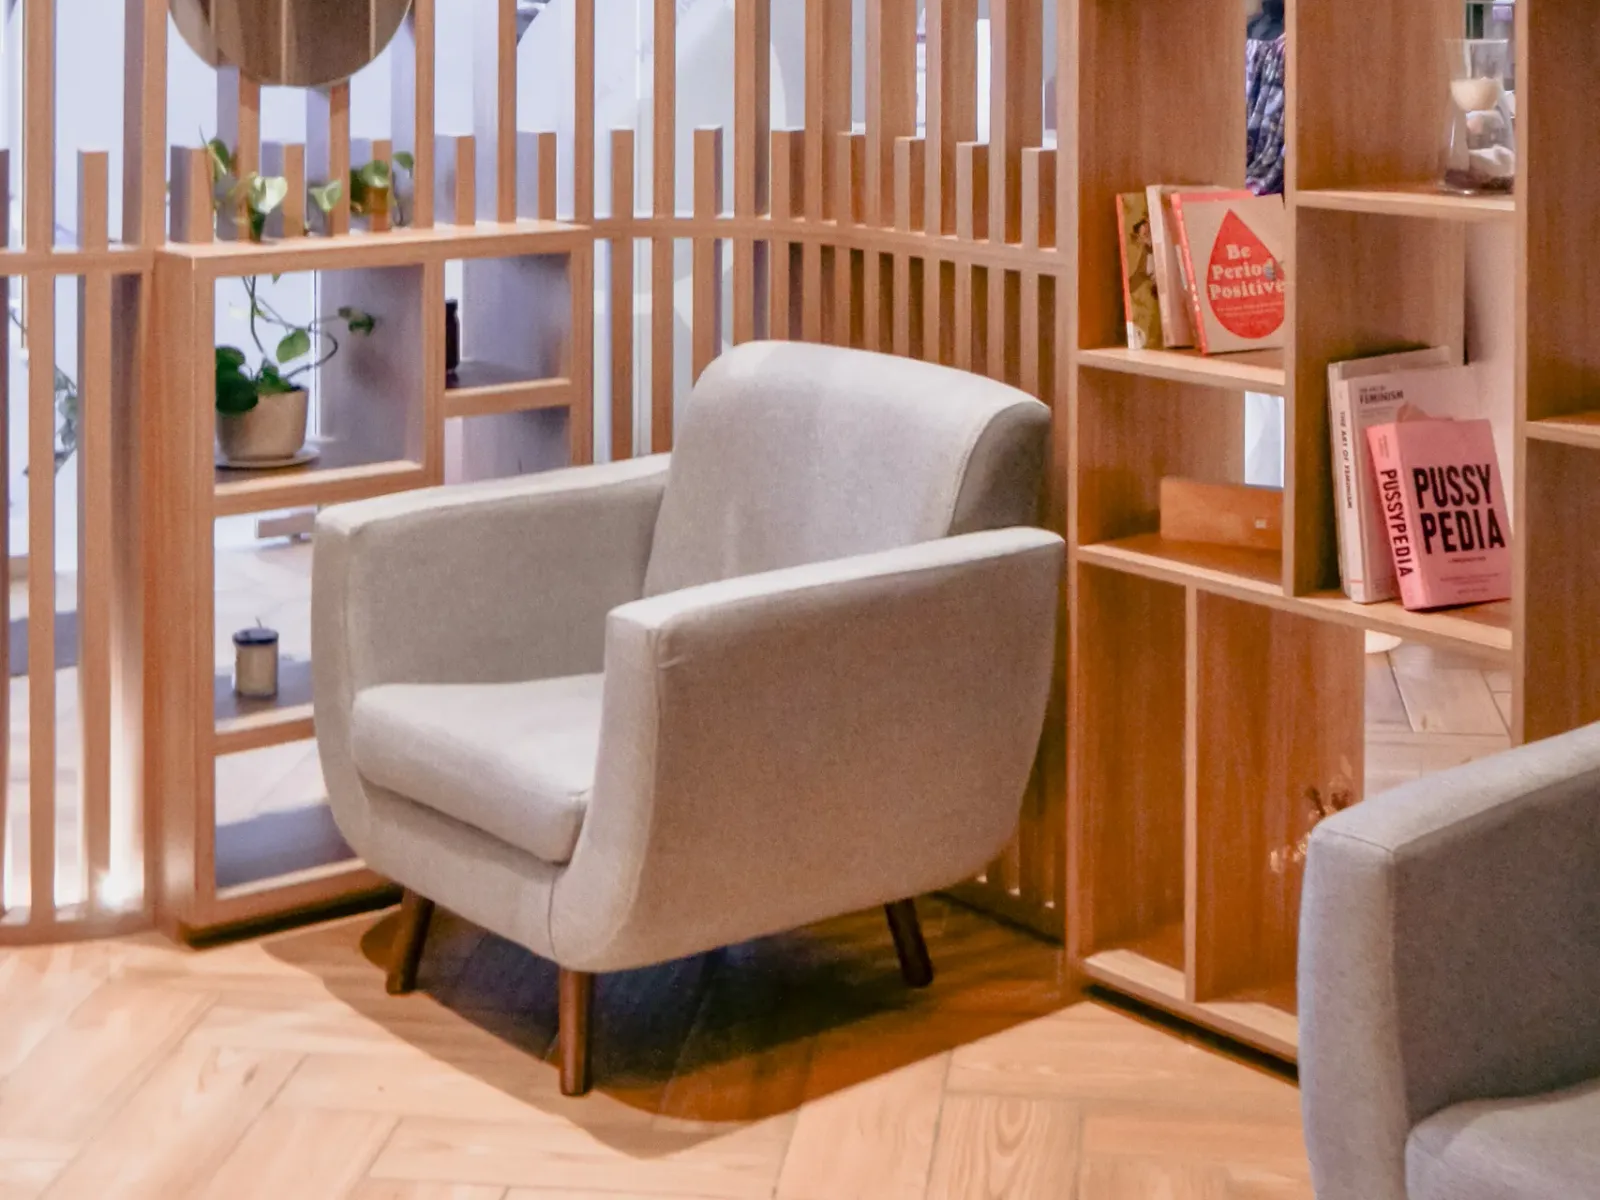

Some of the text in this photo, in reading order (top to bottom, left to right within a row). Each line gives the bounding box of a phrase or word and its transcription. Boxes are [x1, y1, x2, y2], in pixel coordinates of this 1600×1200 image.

[1225, 243, 1251, 261] Be
[1211, 257, 1276, 281] Period
[1209, 279, 1285, 301] Positive
[1359, 389, 1404, 405] FEMINISM
[1412, 463, 1492, 509] PUSSY
[1379, 468, 1414, 578] PUSSYPEDIA
[1419, 507, 1506, 555] PEDIA
